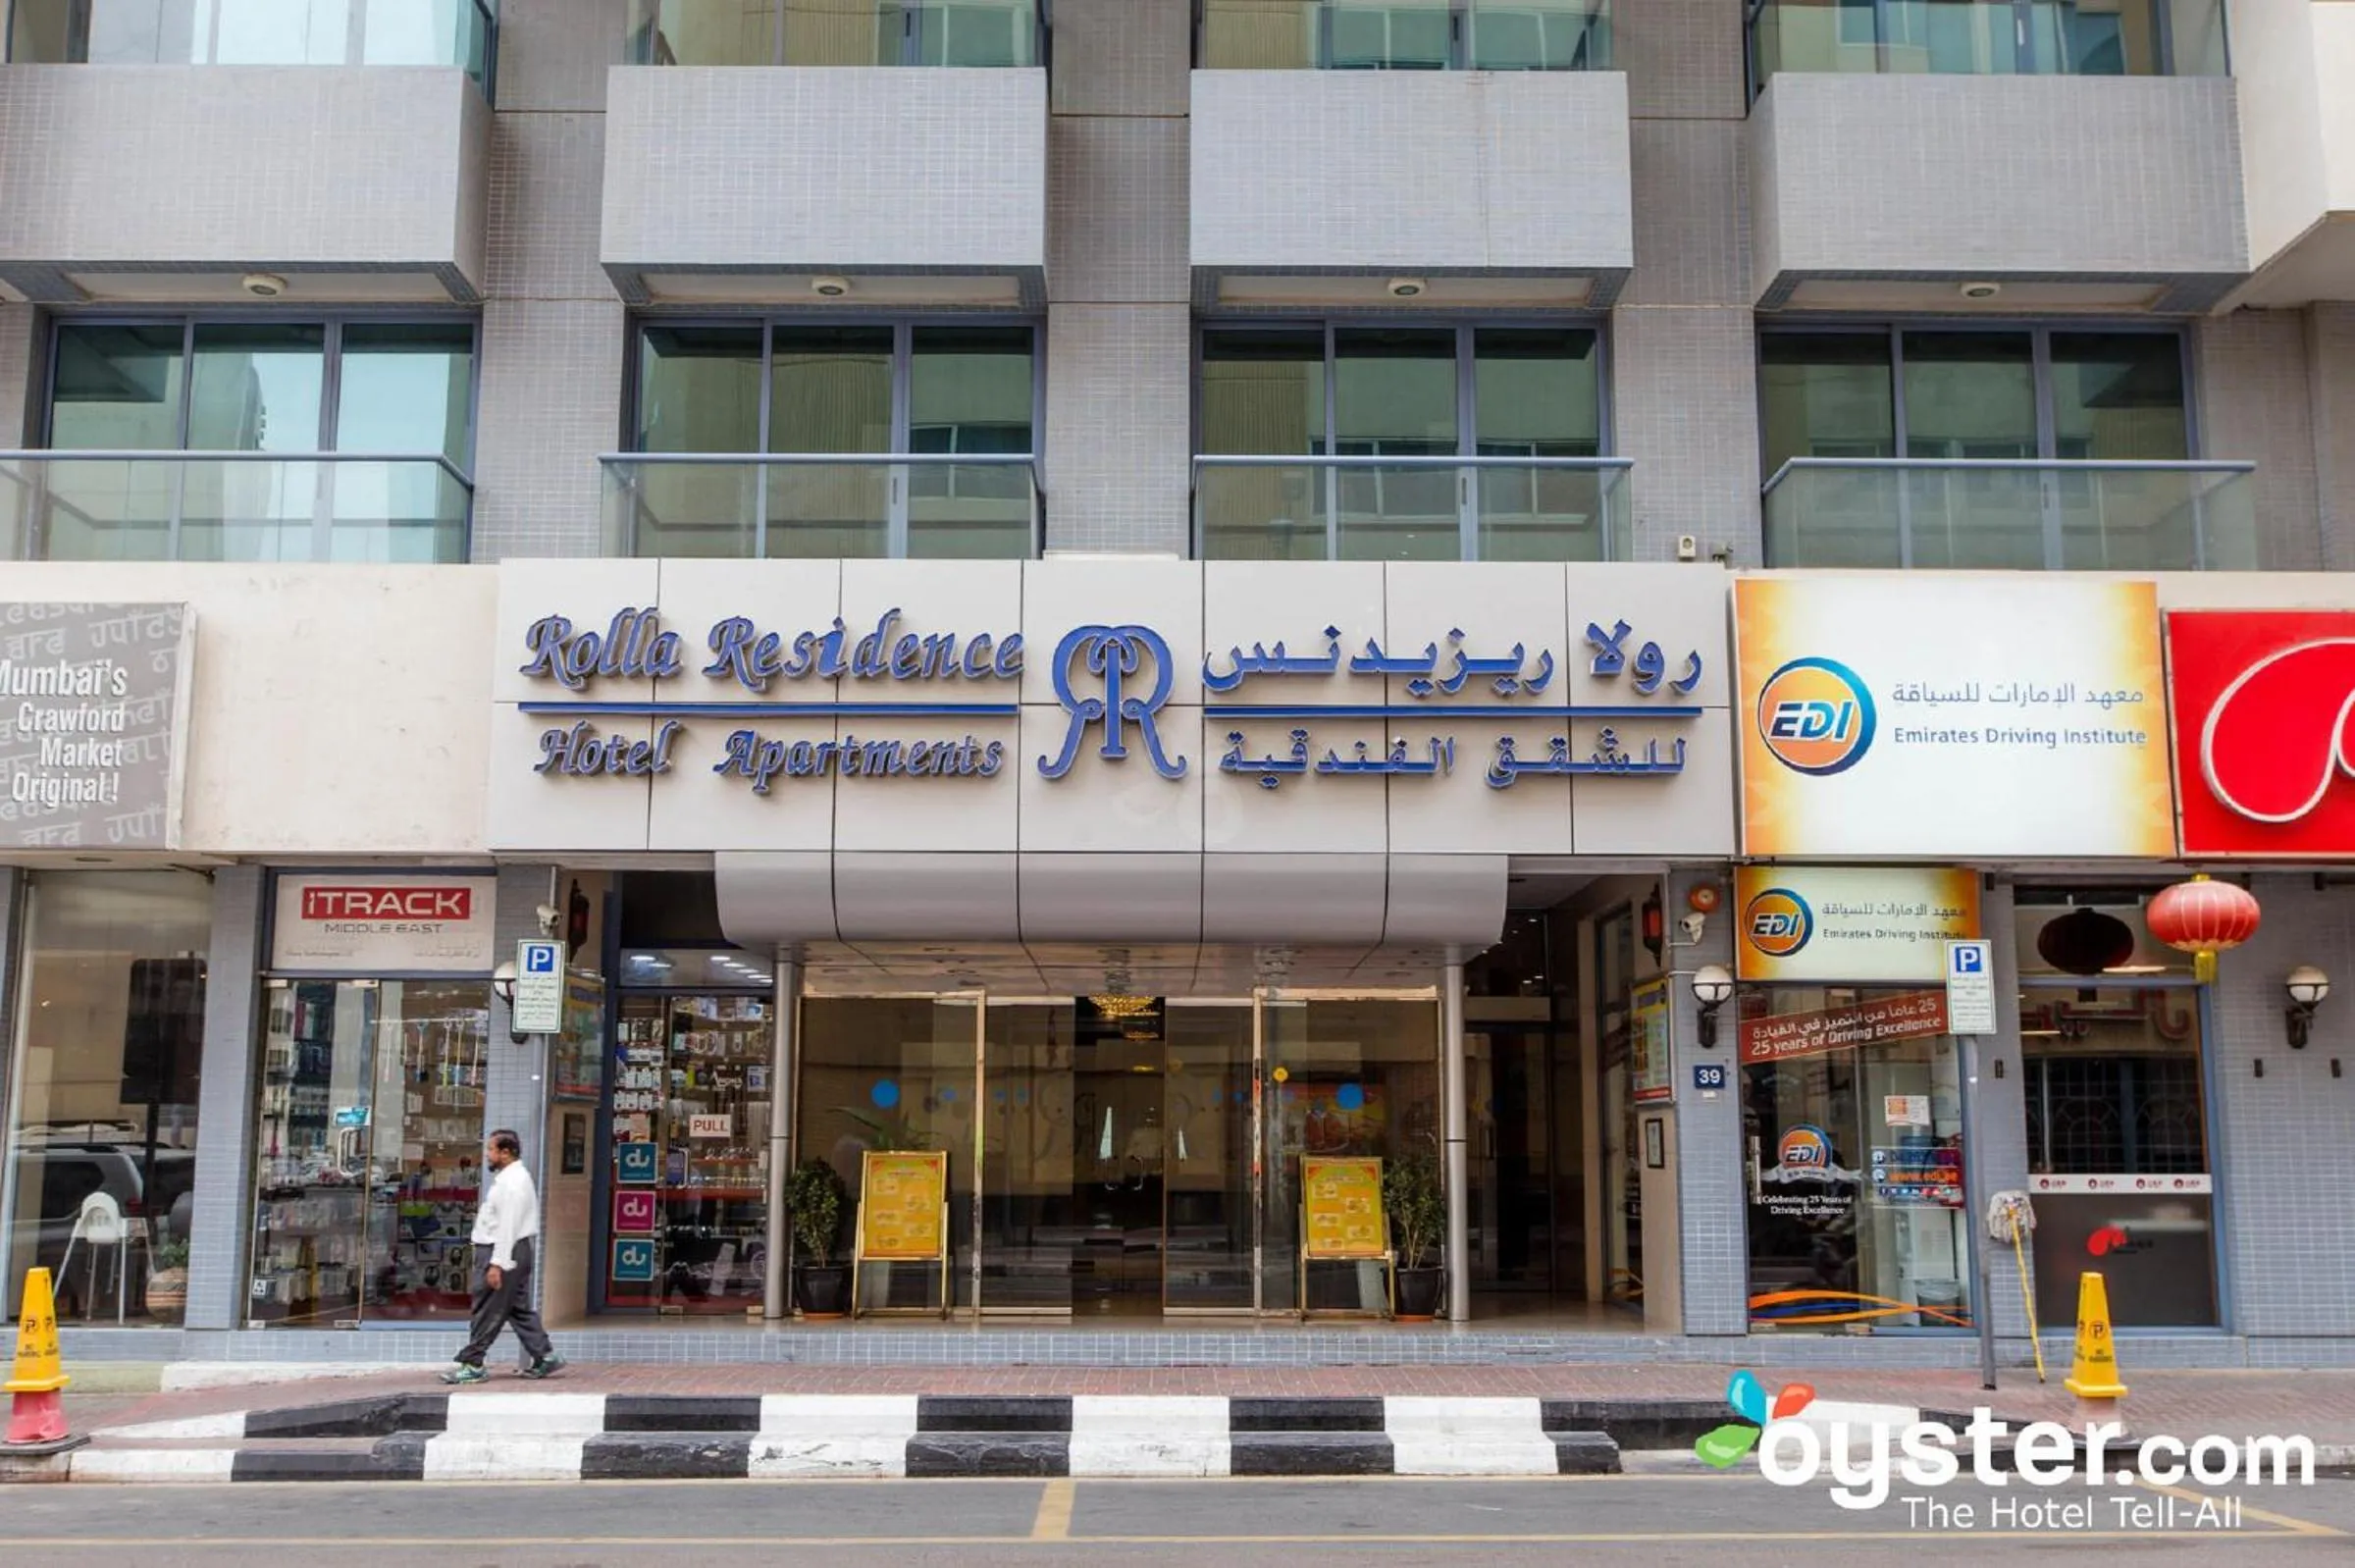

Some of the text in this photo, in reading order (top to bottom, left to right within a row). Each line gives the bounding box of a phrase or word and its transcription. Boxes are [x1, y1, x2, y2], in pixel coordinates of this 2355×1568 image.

[519, 606, 1024, 695] Rolla Residence
[1201, 617, 1702, 697] رولا ريزيدنس
[1892, 681, 1980, 706] للسياقة
[2084, 689, 2145, 710] معهد
[18, 701, 127, 733] Crawford
[1769, 700, 1856, 743] EDI
[1894, 727, 2147, 749] Emirates Driving Institute
[40, 737, 123, 767] Market
[533, 719, 1004, 795] Hotel Apartments
[1218, 725, 1688, 789] للشقق الفندقية
[324, 922, 444, 934] MIDDLE EAST
[1753, 913, 1801, 936] EDI
[1822, 928, 1967, 943] Emirates Driving Institute
[531, 948, 550, 970] P
[1960, 948, 1978, 971] P
[1917, 998, 1937, 1015] 25
[1752, 1017, 1943, 1056] 25 years of Driving Excellence
[1699, 1069, 1721, 1085] 39
[693, 1120, 729, 1132] PULL
[1786, 1145, 1822, 1163] EDI
